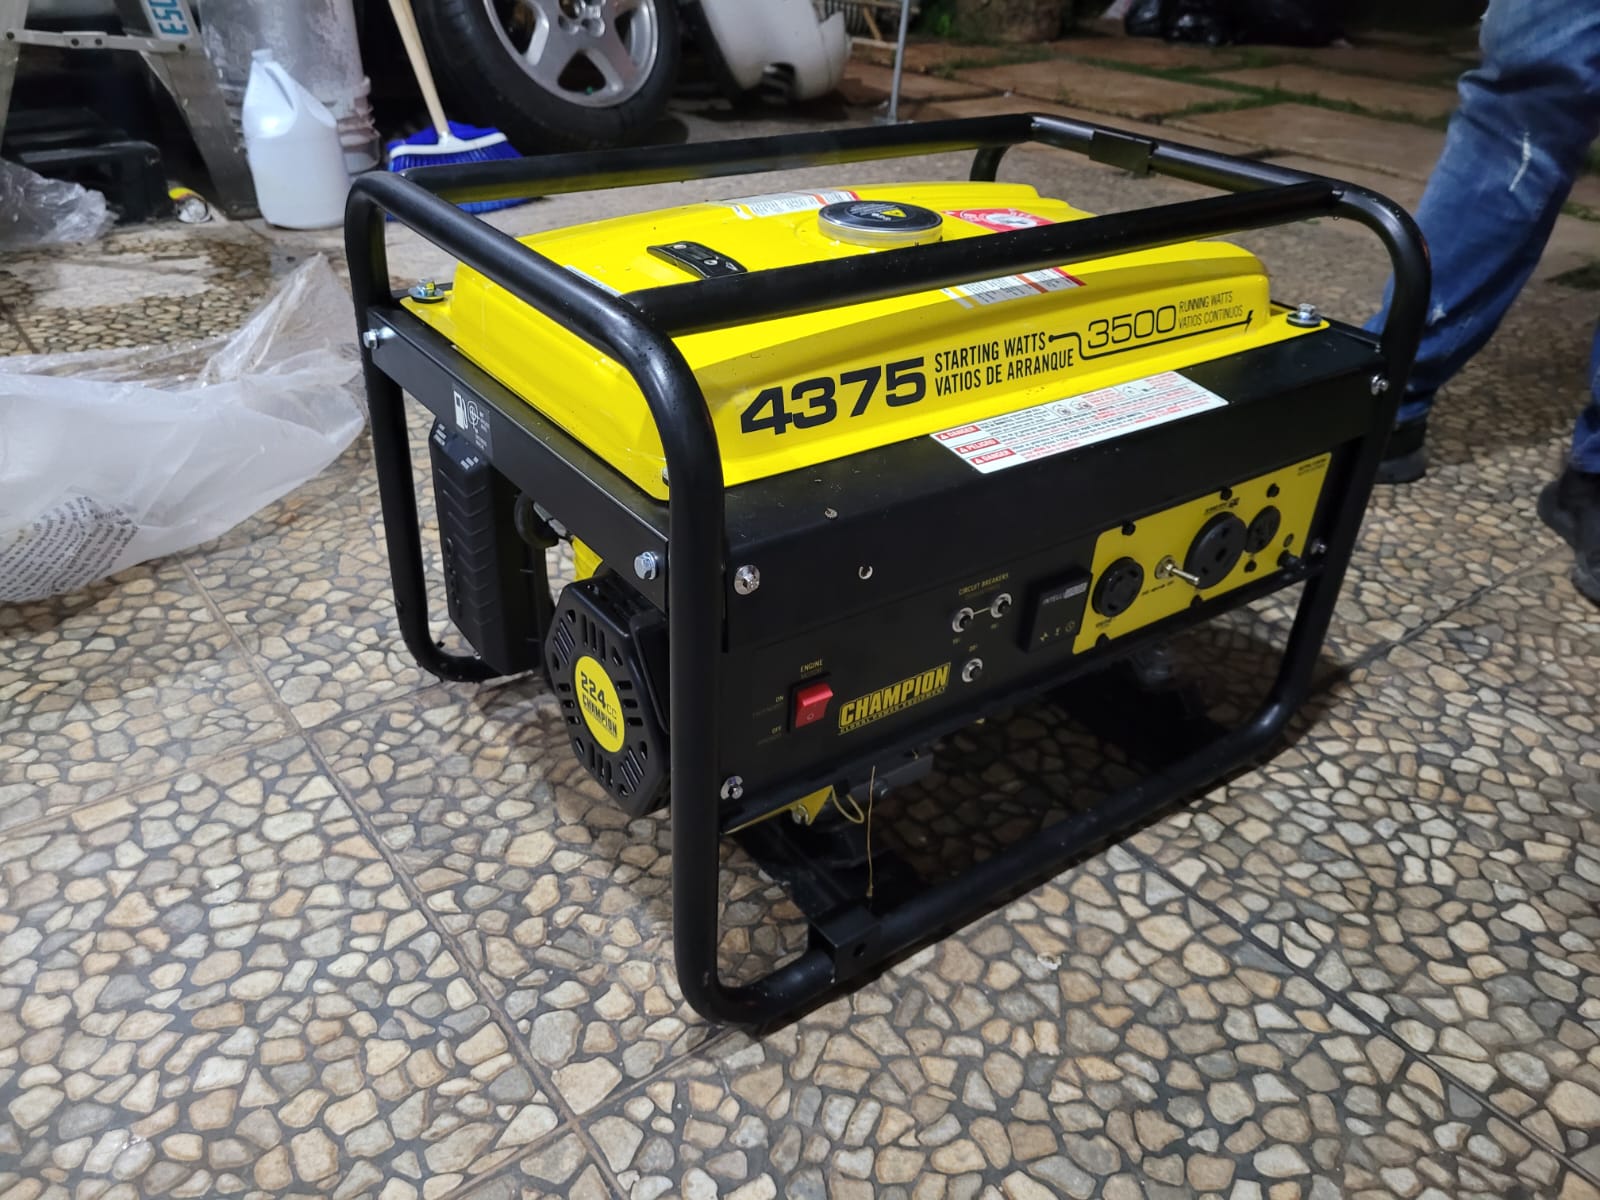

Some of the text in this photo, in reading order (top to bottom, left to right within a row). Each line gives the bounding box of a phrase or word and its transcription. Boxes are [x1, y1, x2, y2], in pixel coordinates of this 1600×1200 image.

[1179, 290, 1233, 313] RUNNING WATTS
[1179, 304, 1243, 329] VATIOS CONTINUOS
[1087, 305, 1177, 349] 3500
[935, 331, 1046, 373] STARTING WATTS
[935, 348, 1074, 397] VATIOS DE ARRANQUE
[740, 356, 926, 436] 4375
[958, 582, 980, 596] CIRCUIT
[982, 573, 1009, 588] BREAKERS
[800, 659, 823, 673] ENGINE
[582, 693, 617, 739] CHAMPION
[840, 664, 950, 727] CHAMPION
